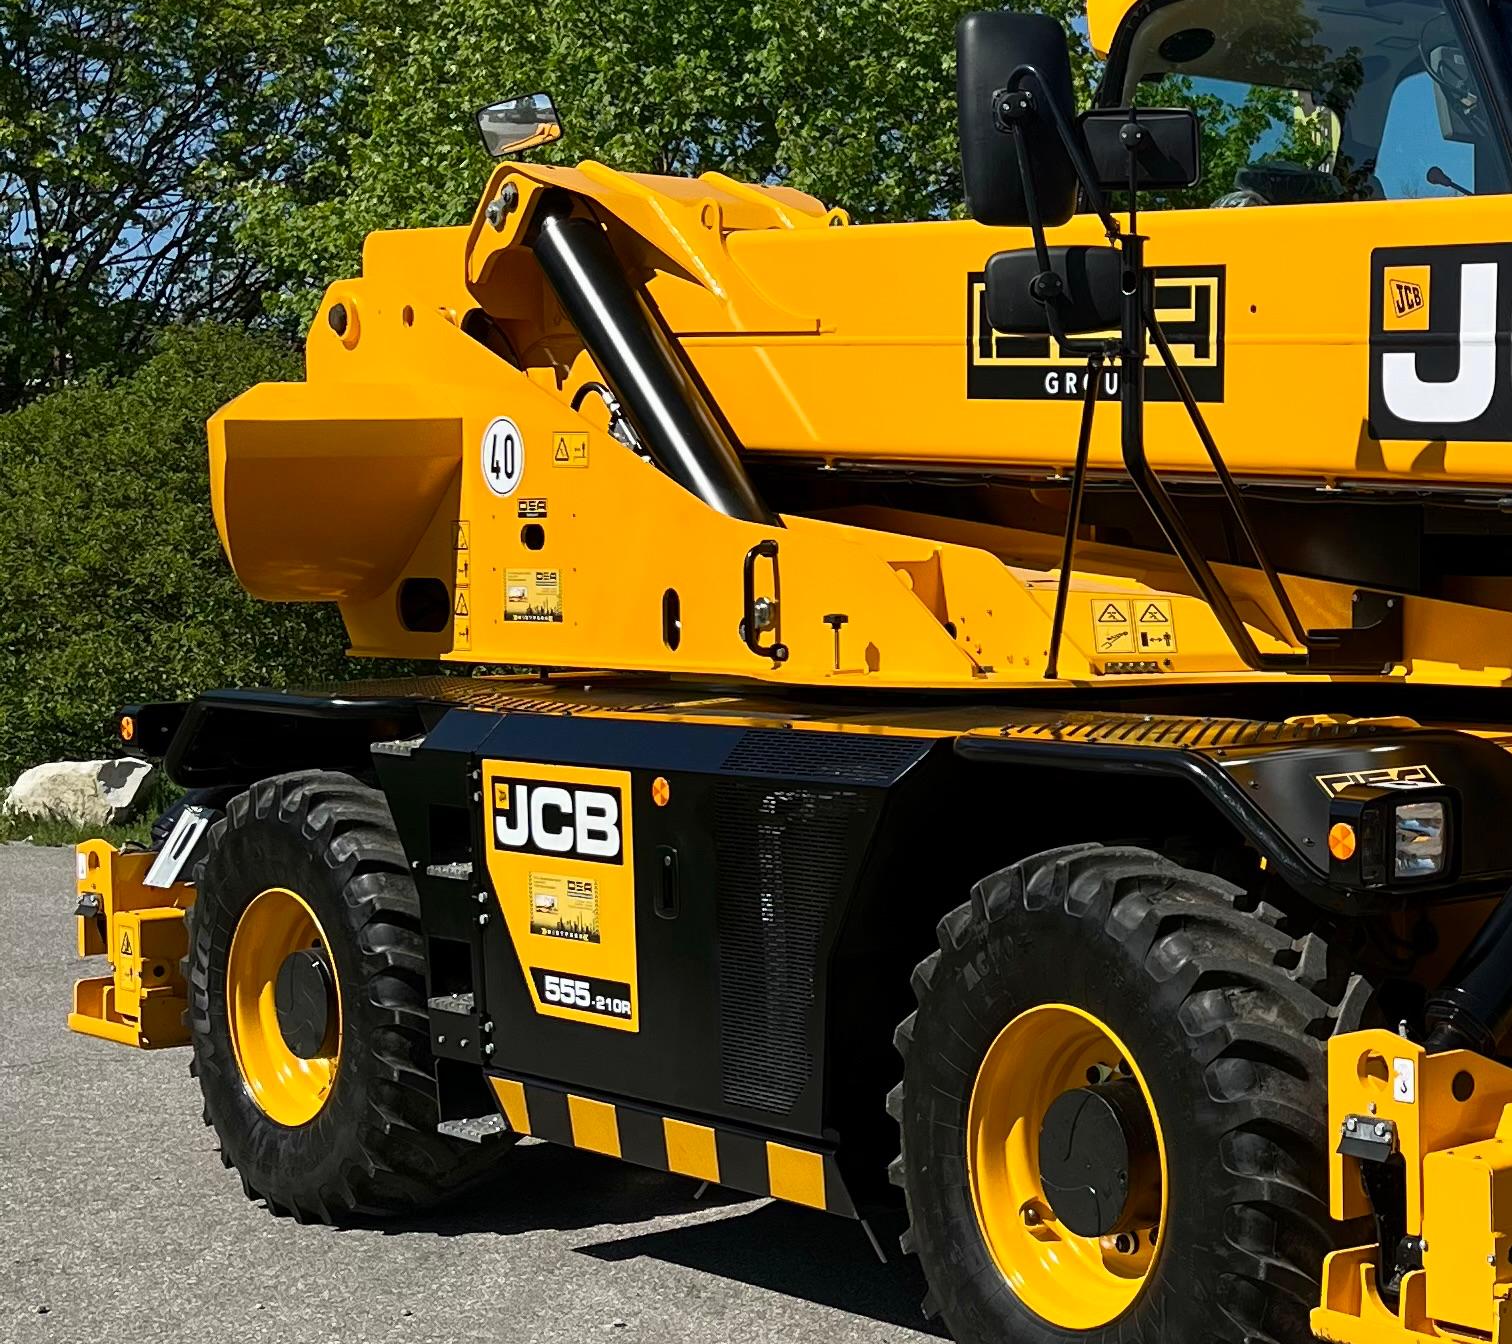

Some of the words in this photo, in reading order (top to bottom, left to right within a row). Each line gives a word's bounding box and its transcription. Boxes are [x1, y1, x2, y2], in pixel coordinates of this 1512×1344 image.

[1395, 283, 1422, 314] JCB
[1045, 372, 1119, 395] GRU
[491, 434, 514, 479] 40
[495, 784, 621, 857] JCB
